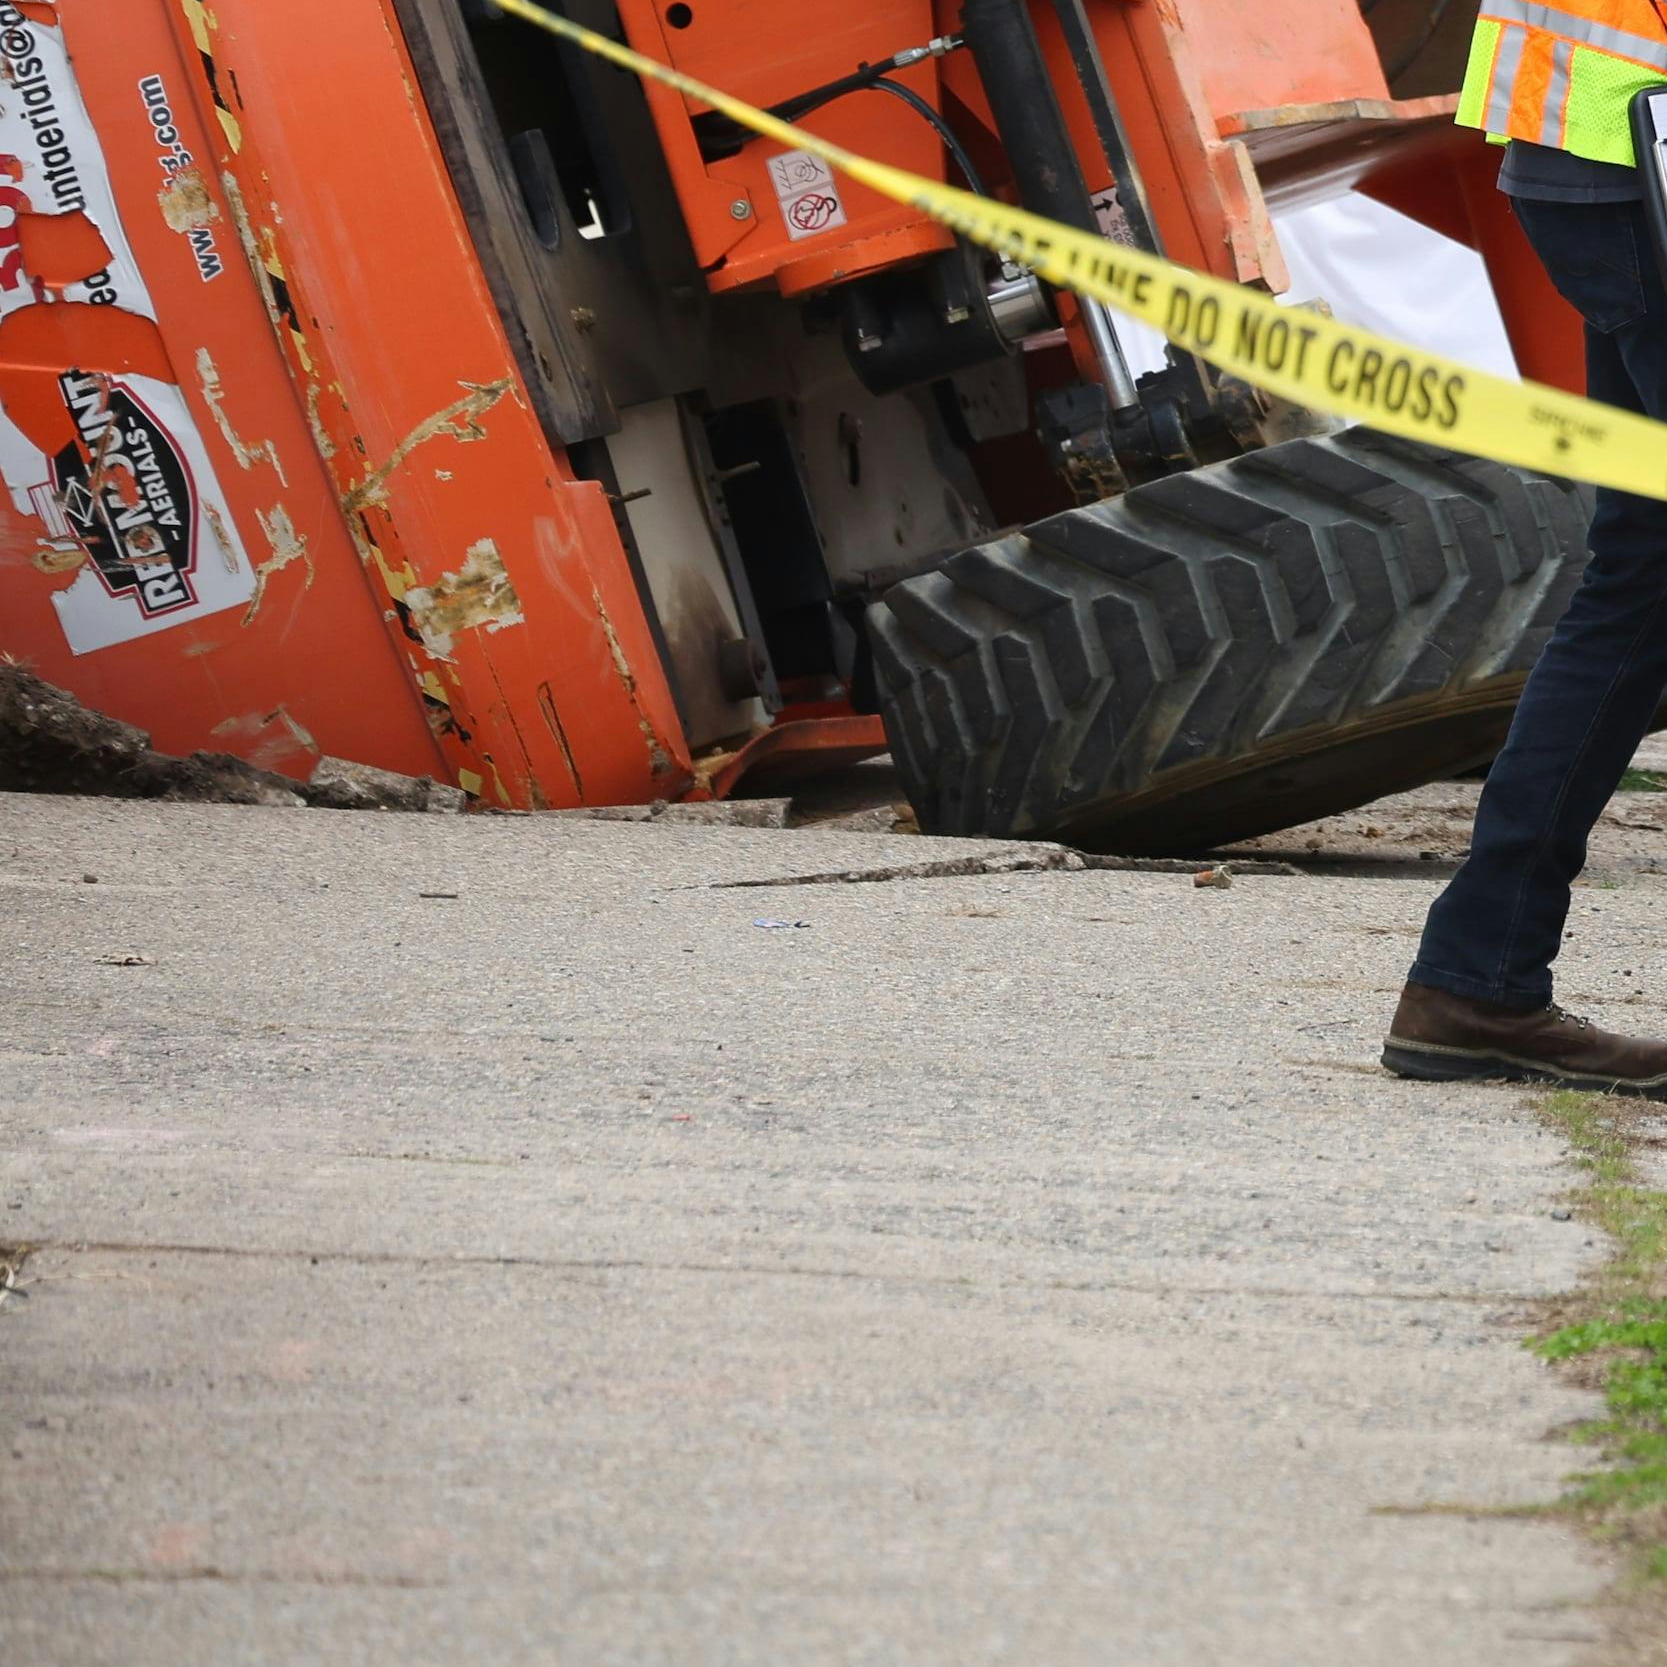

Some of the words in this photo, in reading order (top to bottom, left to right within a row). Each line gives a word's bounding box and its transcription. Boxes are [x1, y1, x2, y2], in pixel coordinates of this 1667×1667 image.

[1166, 287, 1220, 348] DO
[1234, 309, 1318, 381] NOT
[1327, 340, 1467, 431] CROSS
